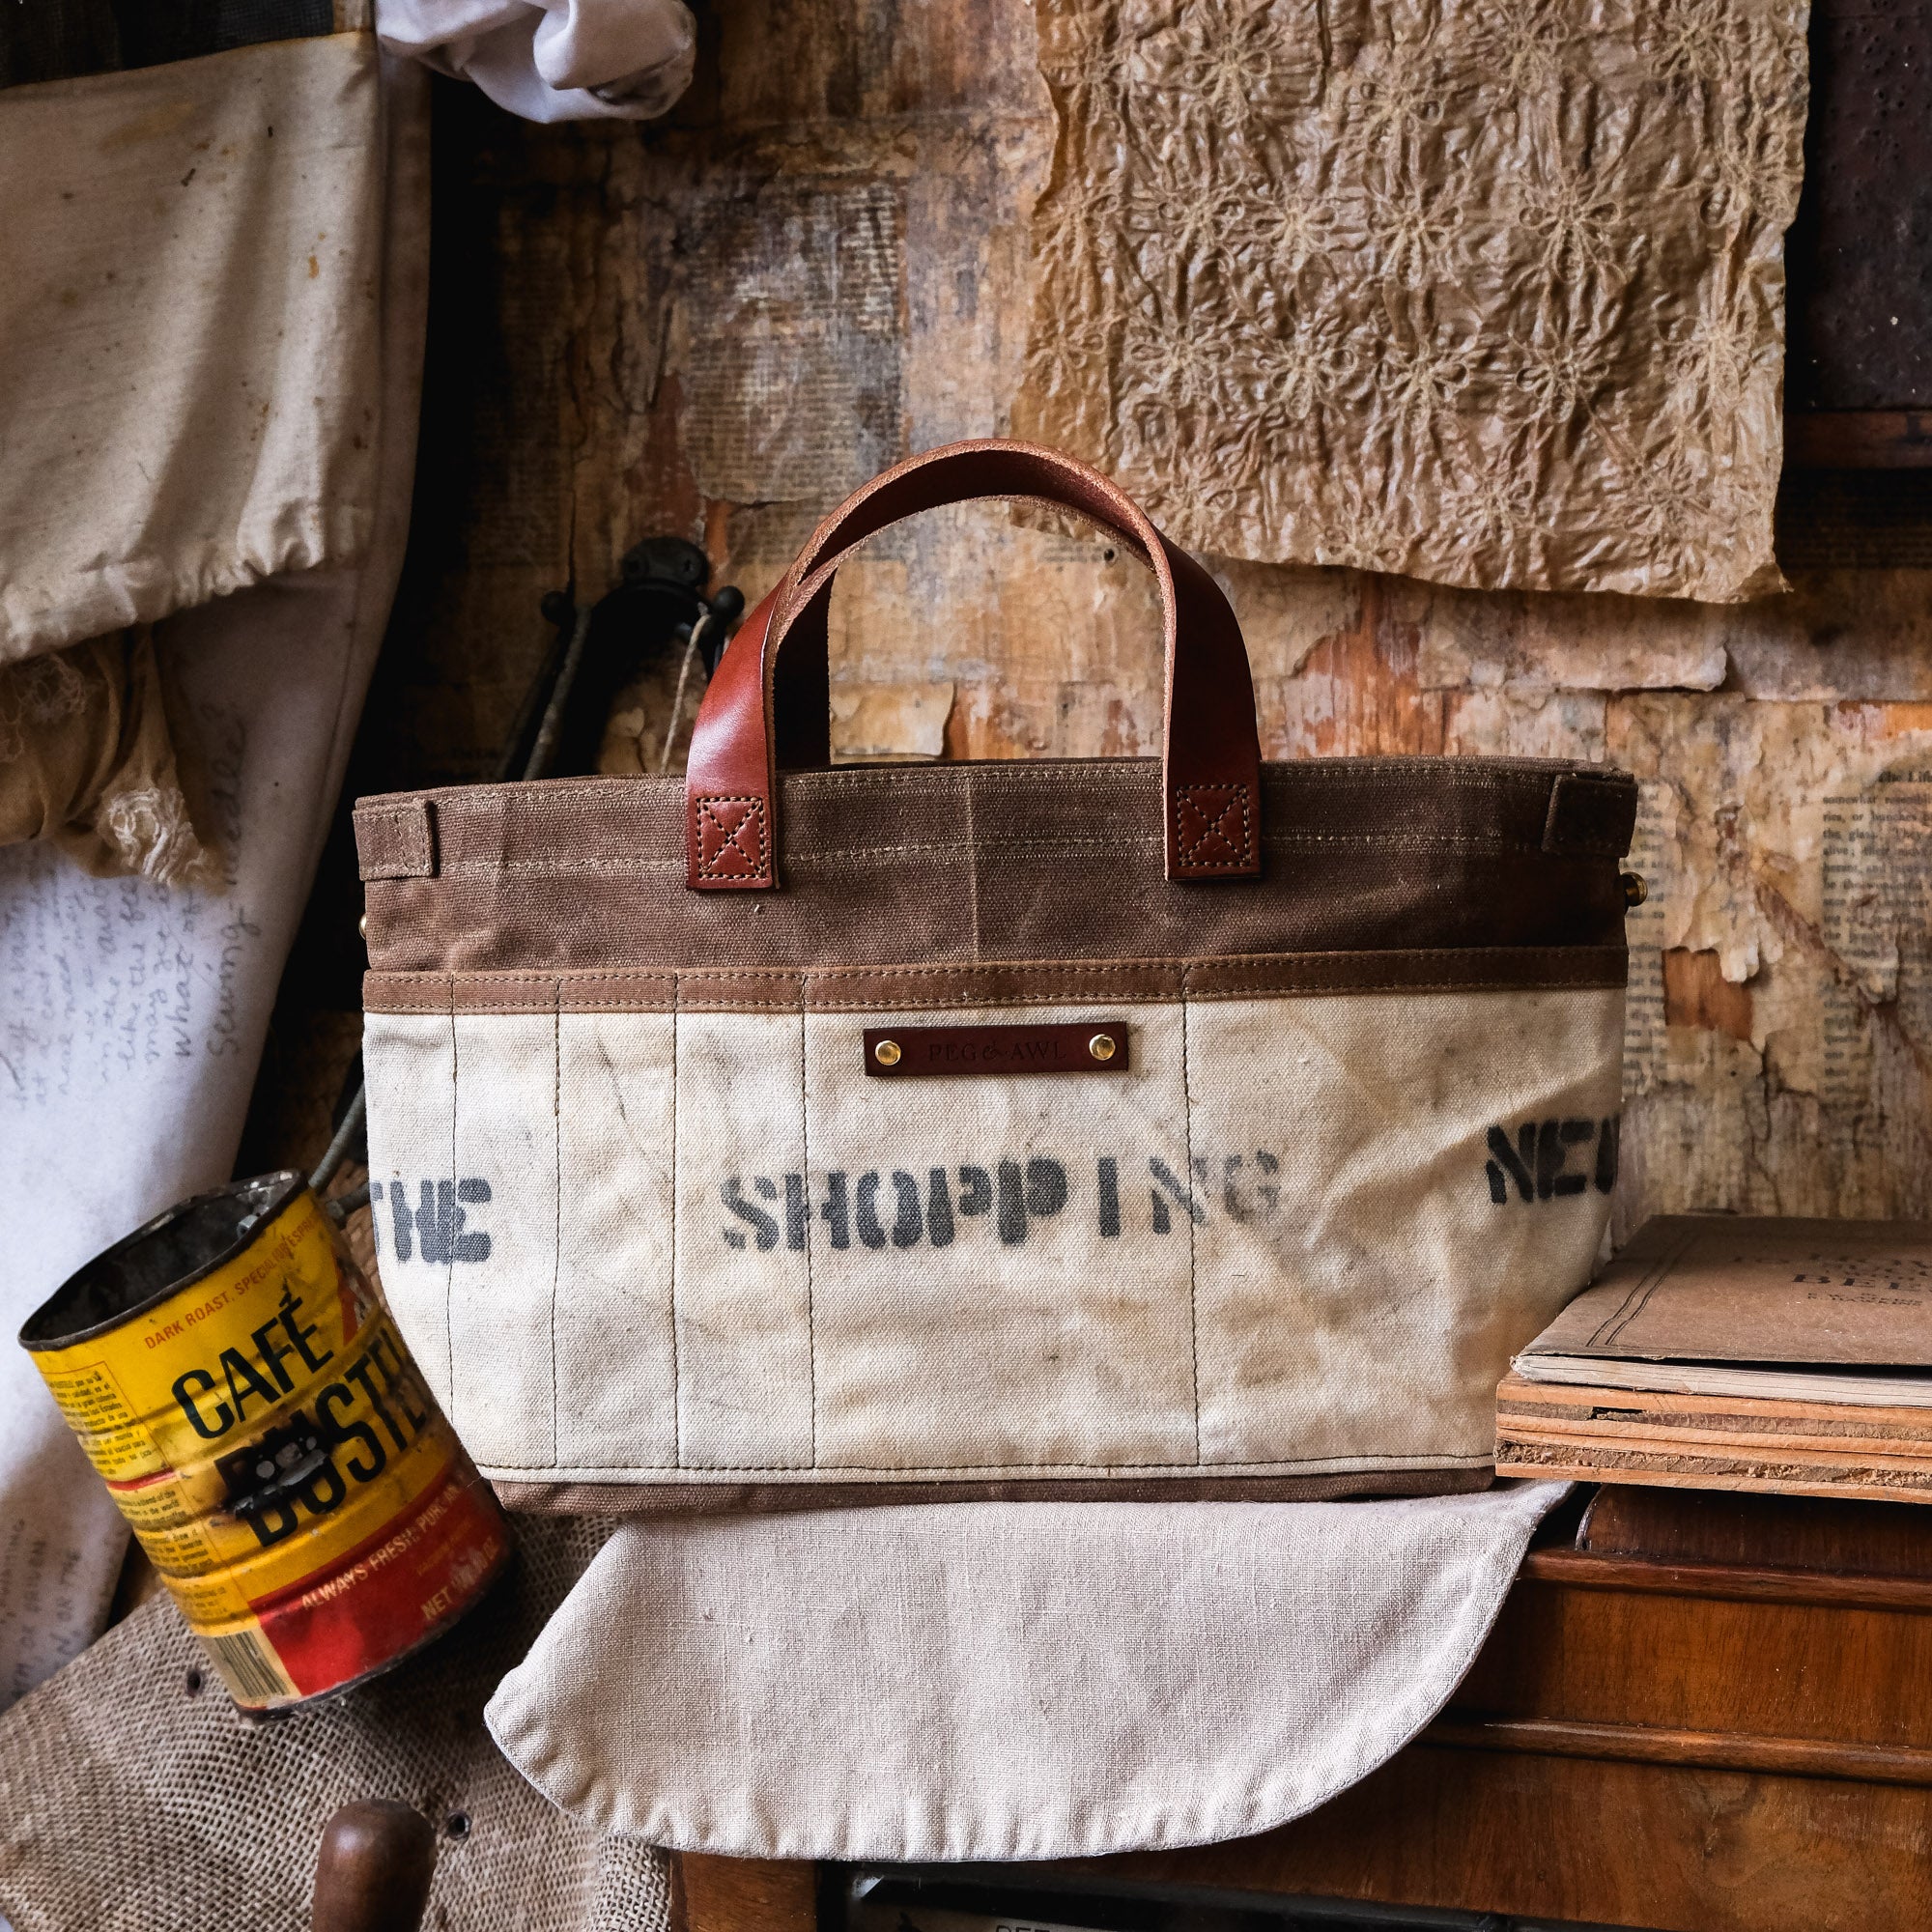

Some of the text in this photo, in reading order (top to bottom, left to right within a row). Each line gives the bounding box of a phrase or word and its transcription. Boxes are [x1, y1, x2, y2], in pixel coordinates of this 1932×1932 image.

[928, 1042, 977, 1062] PEG
[1011, 1040, 1066, 1061] AWL
[721, 1151, 1279, 1253] SHOPPING
[145, 1320, 184, 1350] DARK
[172, 1292, 334, 1438] CAFÉ
[301, 1563, 369, 1610] ALWAYS
[419, 1585, 454, 1621] NET
